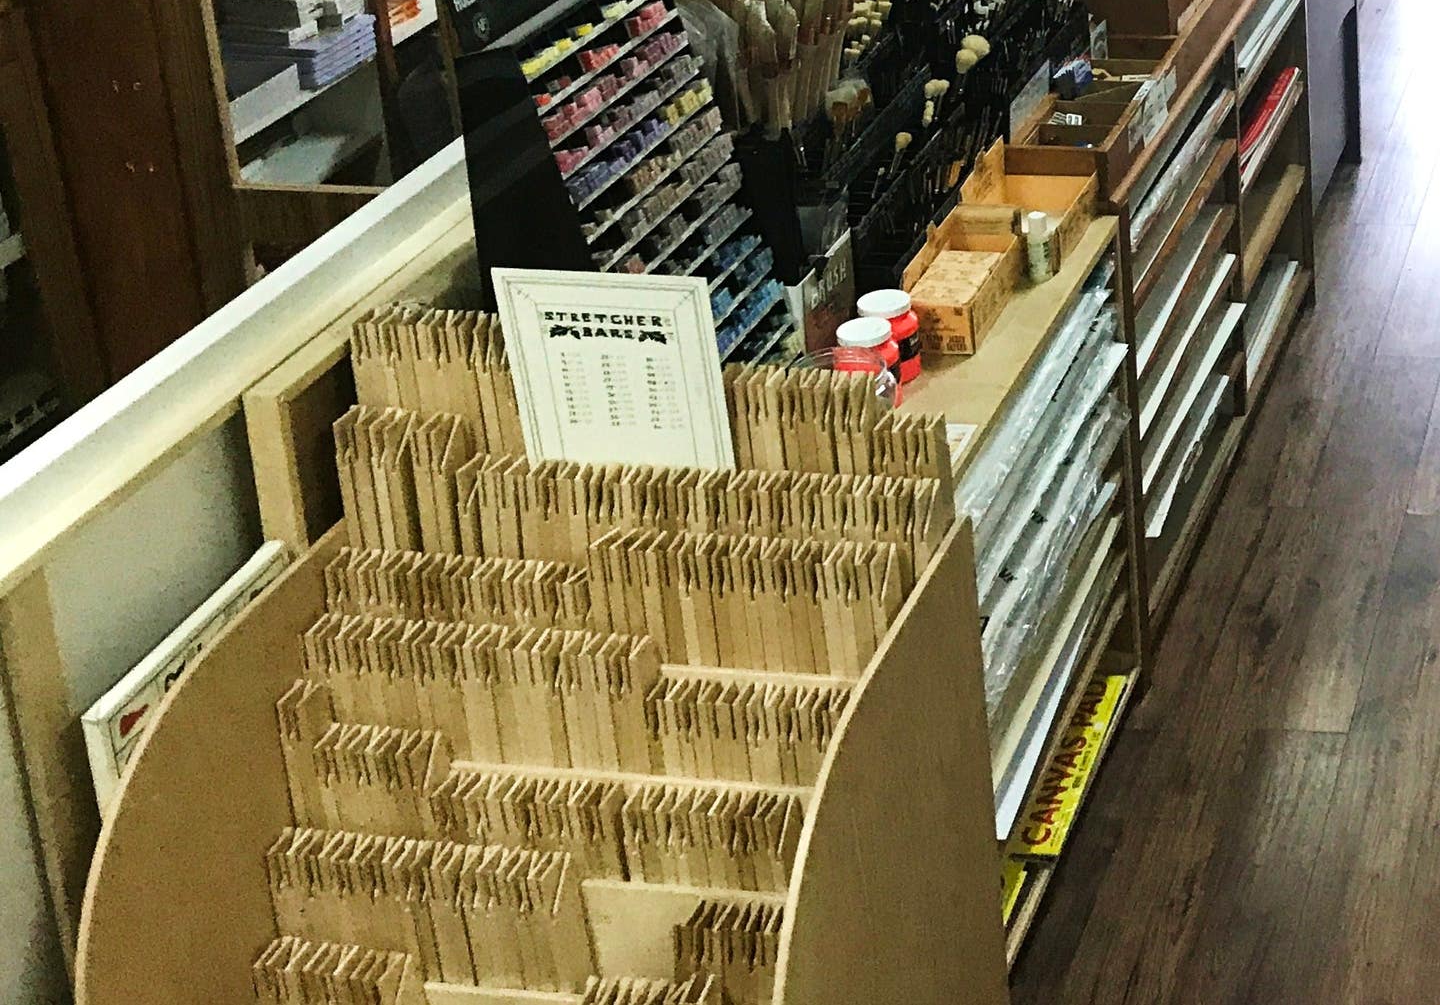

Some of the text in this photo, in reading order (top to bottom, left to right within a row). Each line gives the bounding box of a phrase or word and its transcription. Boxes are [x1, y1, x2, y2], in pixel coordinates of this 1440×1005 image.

[544, 311, 663, 327] STRETCHER
[583, 327, 634, 340] BARS
[1021, 736, 1088, 846] CANVAS
[1071, 681, 1107, 727] PAD
